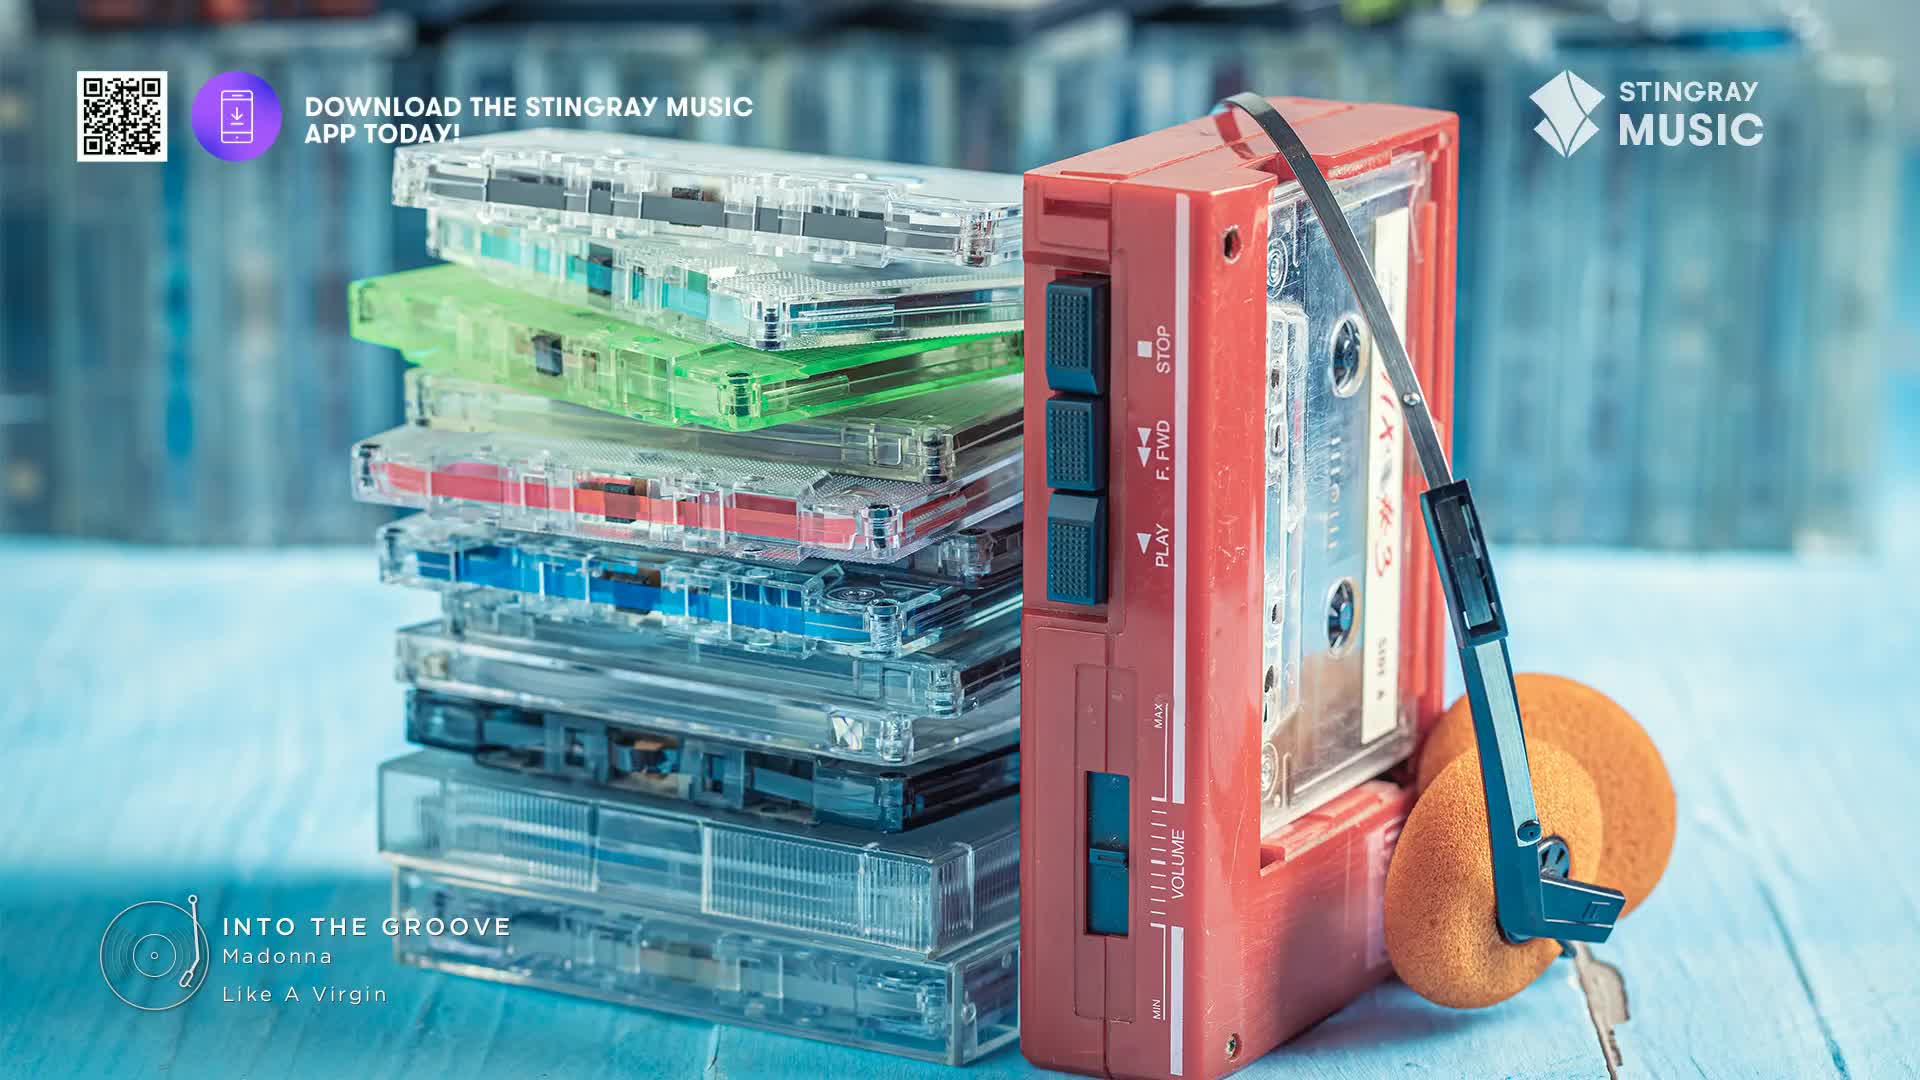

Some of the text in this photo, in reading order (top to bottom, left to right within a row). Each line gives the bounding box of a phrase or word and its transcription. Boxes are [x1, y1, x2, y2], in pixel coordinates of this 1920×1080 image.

[1156, 325, 1171, 374] STOP
[1156, 420, 1170, 481] F. FWD
[1155, 523, 1170, 568] PLAY
[1153, 703, 1164, 729] MAX
[1170, 829, 1186, 900] VOLUME
[1152, 999, 1161, 1020] MIN
